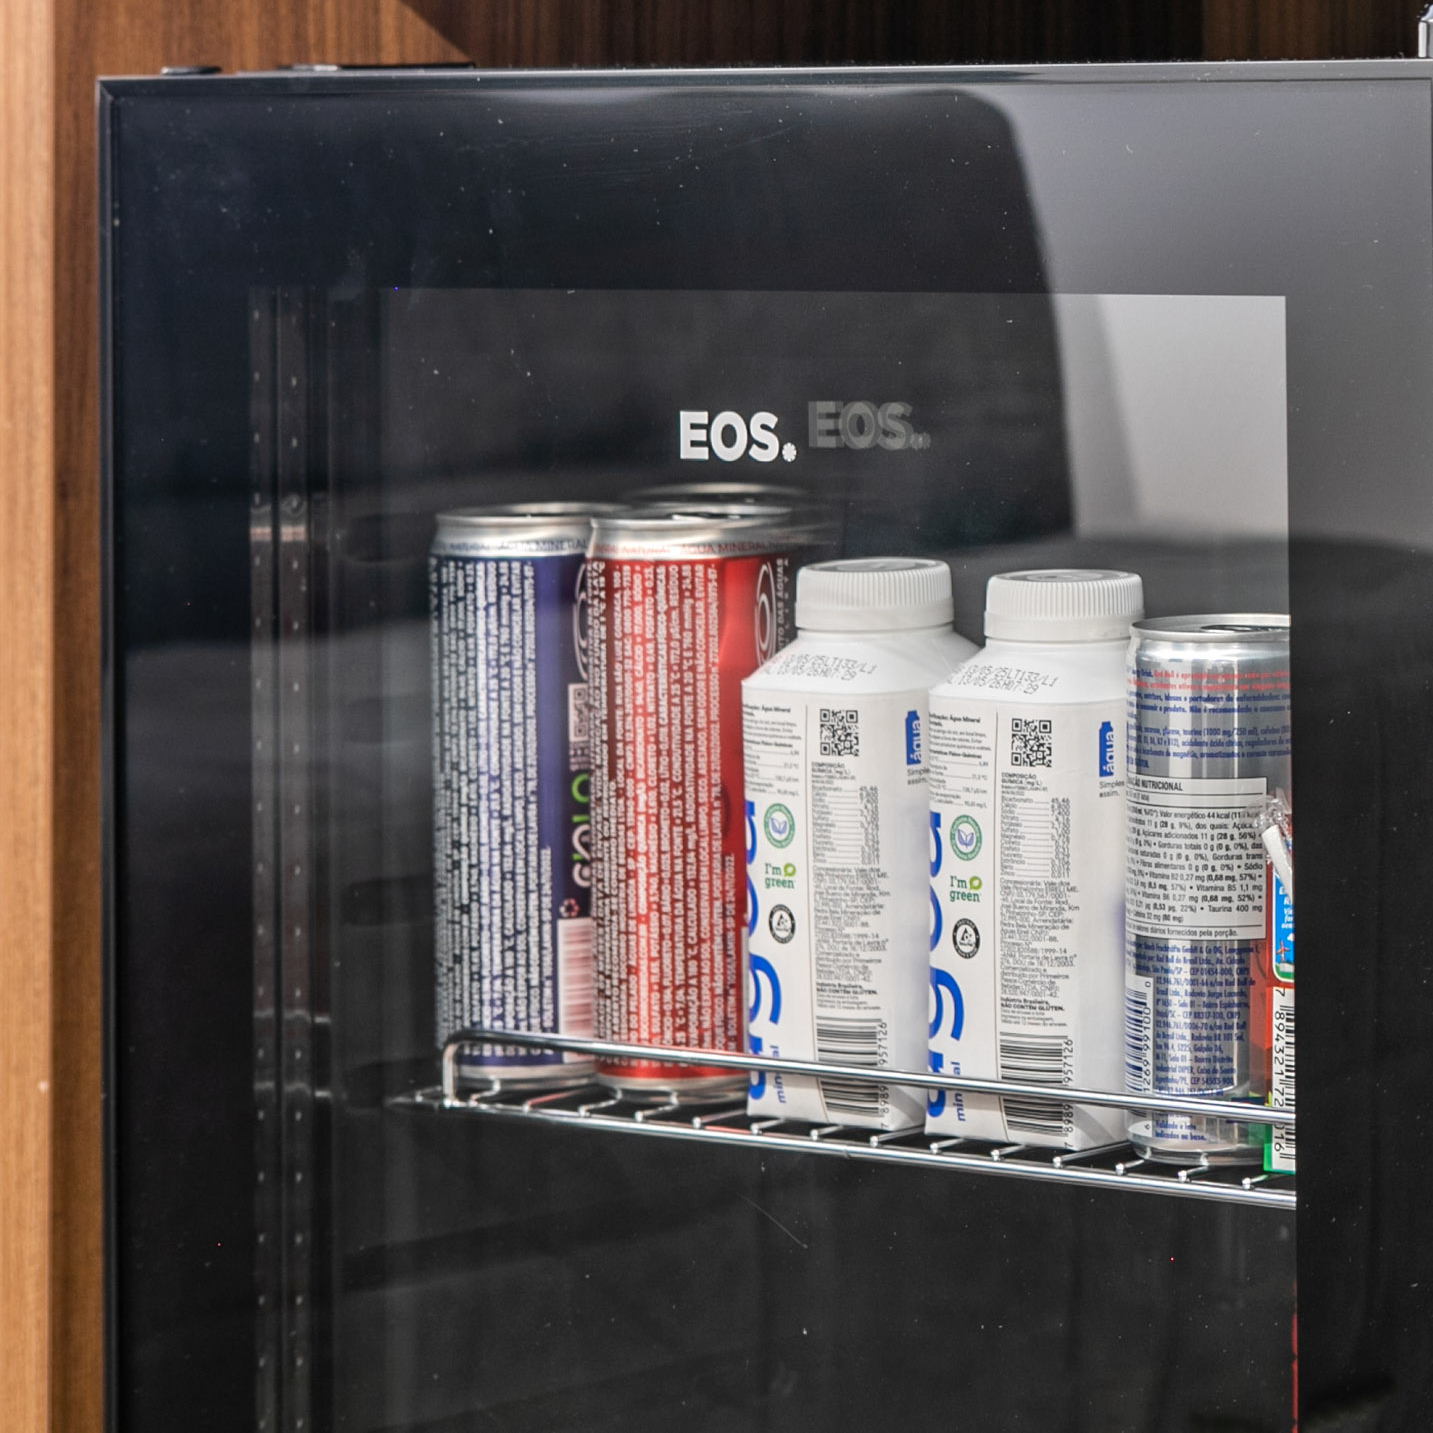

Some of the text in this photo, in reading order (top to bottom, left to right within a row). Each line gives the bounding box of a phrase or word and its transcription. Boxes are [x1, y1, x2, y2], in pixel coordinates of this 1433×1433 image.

[684, 695, 694, 726] FONTE
[685, 727, 694, 742] NA
[1102, 731, 1114, 773] água
[907, 767, 930, 776] Simple
[1141, 779, 1183, 791] NUTRICIONAL
[673, 825, 683, 857] FONTE
[1212, 852, 1263, 861] Gorduras trans
[674, 857, 683, 872] NA
[1244, 863, 1263, 871] Sódio
[673, 874, 684, 900] ÁGUA
[765, 877, 794, 889] green
[950, 875, 967, 889] I'm
[1196, 884, 1225, 892] Vitamina
[1252, 884, 1263, 893] mg
[949, 890, 980, 902] green
[674, 902, 684, 915] DA
[1208, 904, 1263, 913] Taurina 400 mg
[1199, 929, 1213, 938] pela
[1275, 987, 1285, 997] 7
[1143, 1007, 1151, 1052] 99100
[879, 1022, 889, 1066] 957126
[1274, 1010, 1285, 1076] 894321
[1063, 1038, 1073, 1083] 957126
[770, 1045, 787, 1104] minal
[950, 1061, 967, 1123] minal
